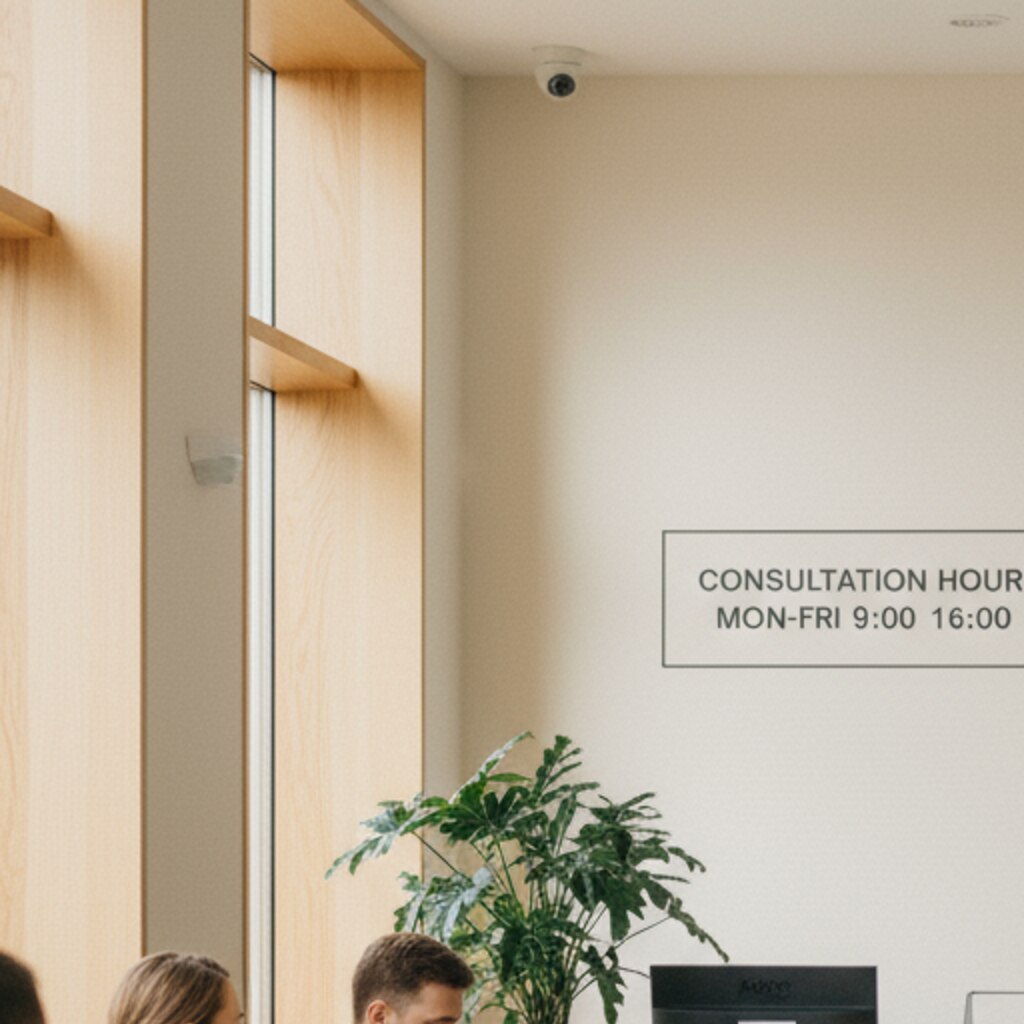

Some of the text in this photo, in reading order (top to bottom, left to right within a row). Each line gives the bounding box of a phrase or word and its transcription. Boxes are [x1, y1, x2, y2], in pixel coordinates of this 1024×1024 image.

[698, 568, 927, 593] CONSULTATION
[717, 605, 1012, 630] MON-FRI 9:00 16:00
